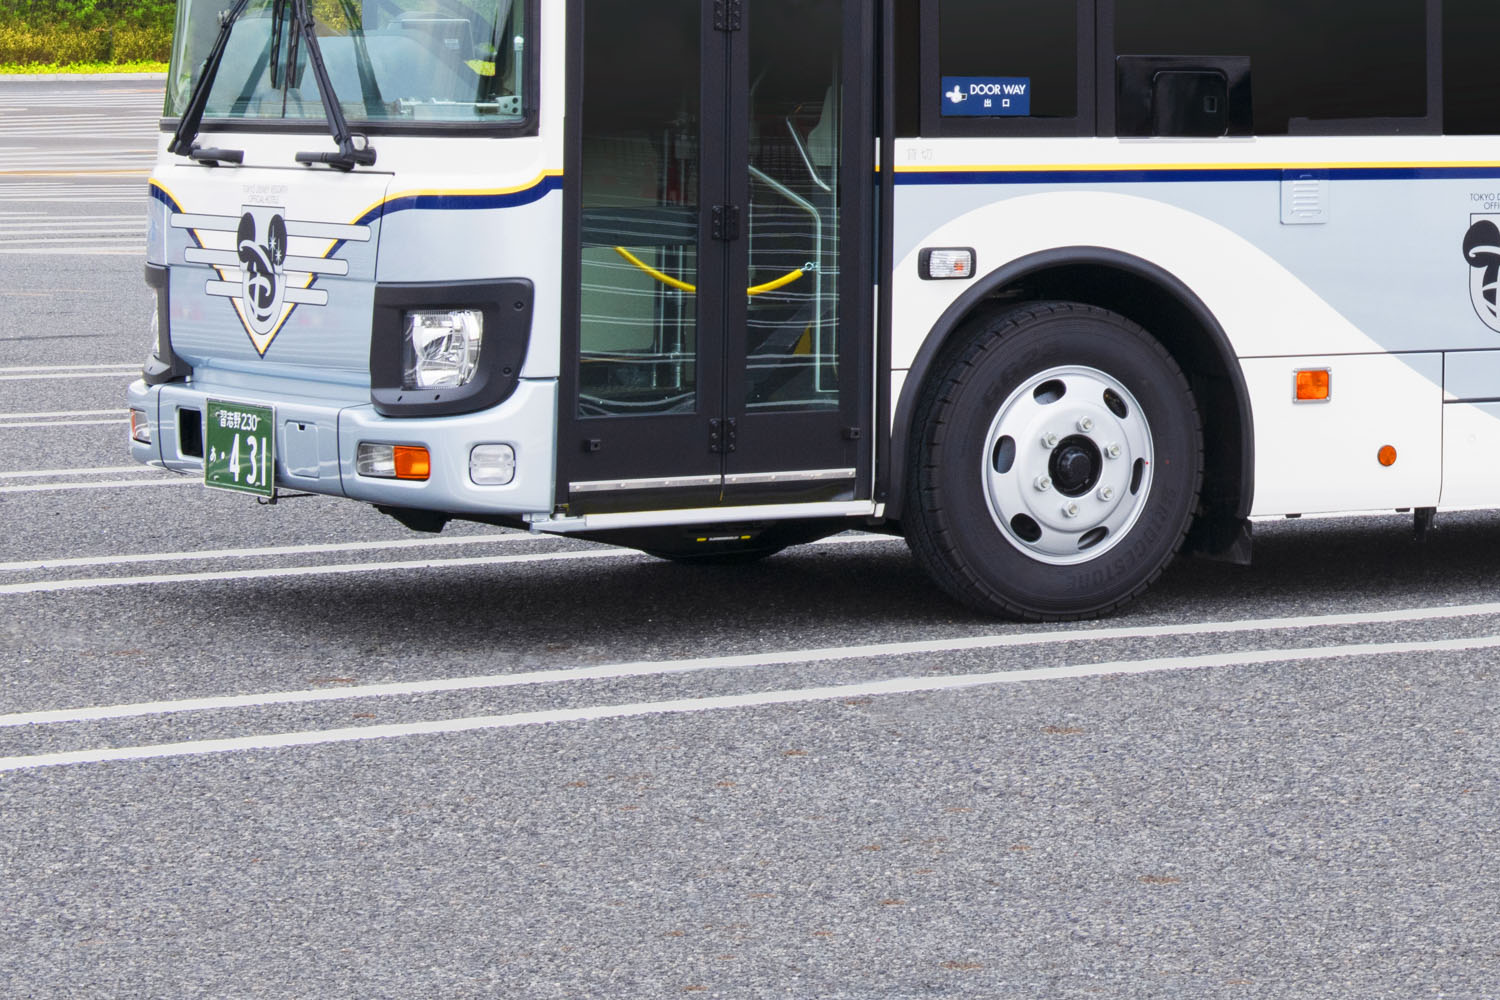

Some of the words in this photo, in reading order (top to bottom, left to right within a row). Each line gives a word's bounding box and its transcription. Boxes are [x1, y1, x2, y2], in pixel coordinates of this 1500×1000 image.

[970, 83, 1001, 95] DOOR
[1002, 84, 1027, 95] WAY
[1470, 192, 1495, 201] TOKYO
